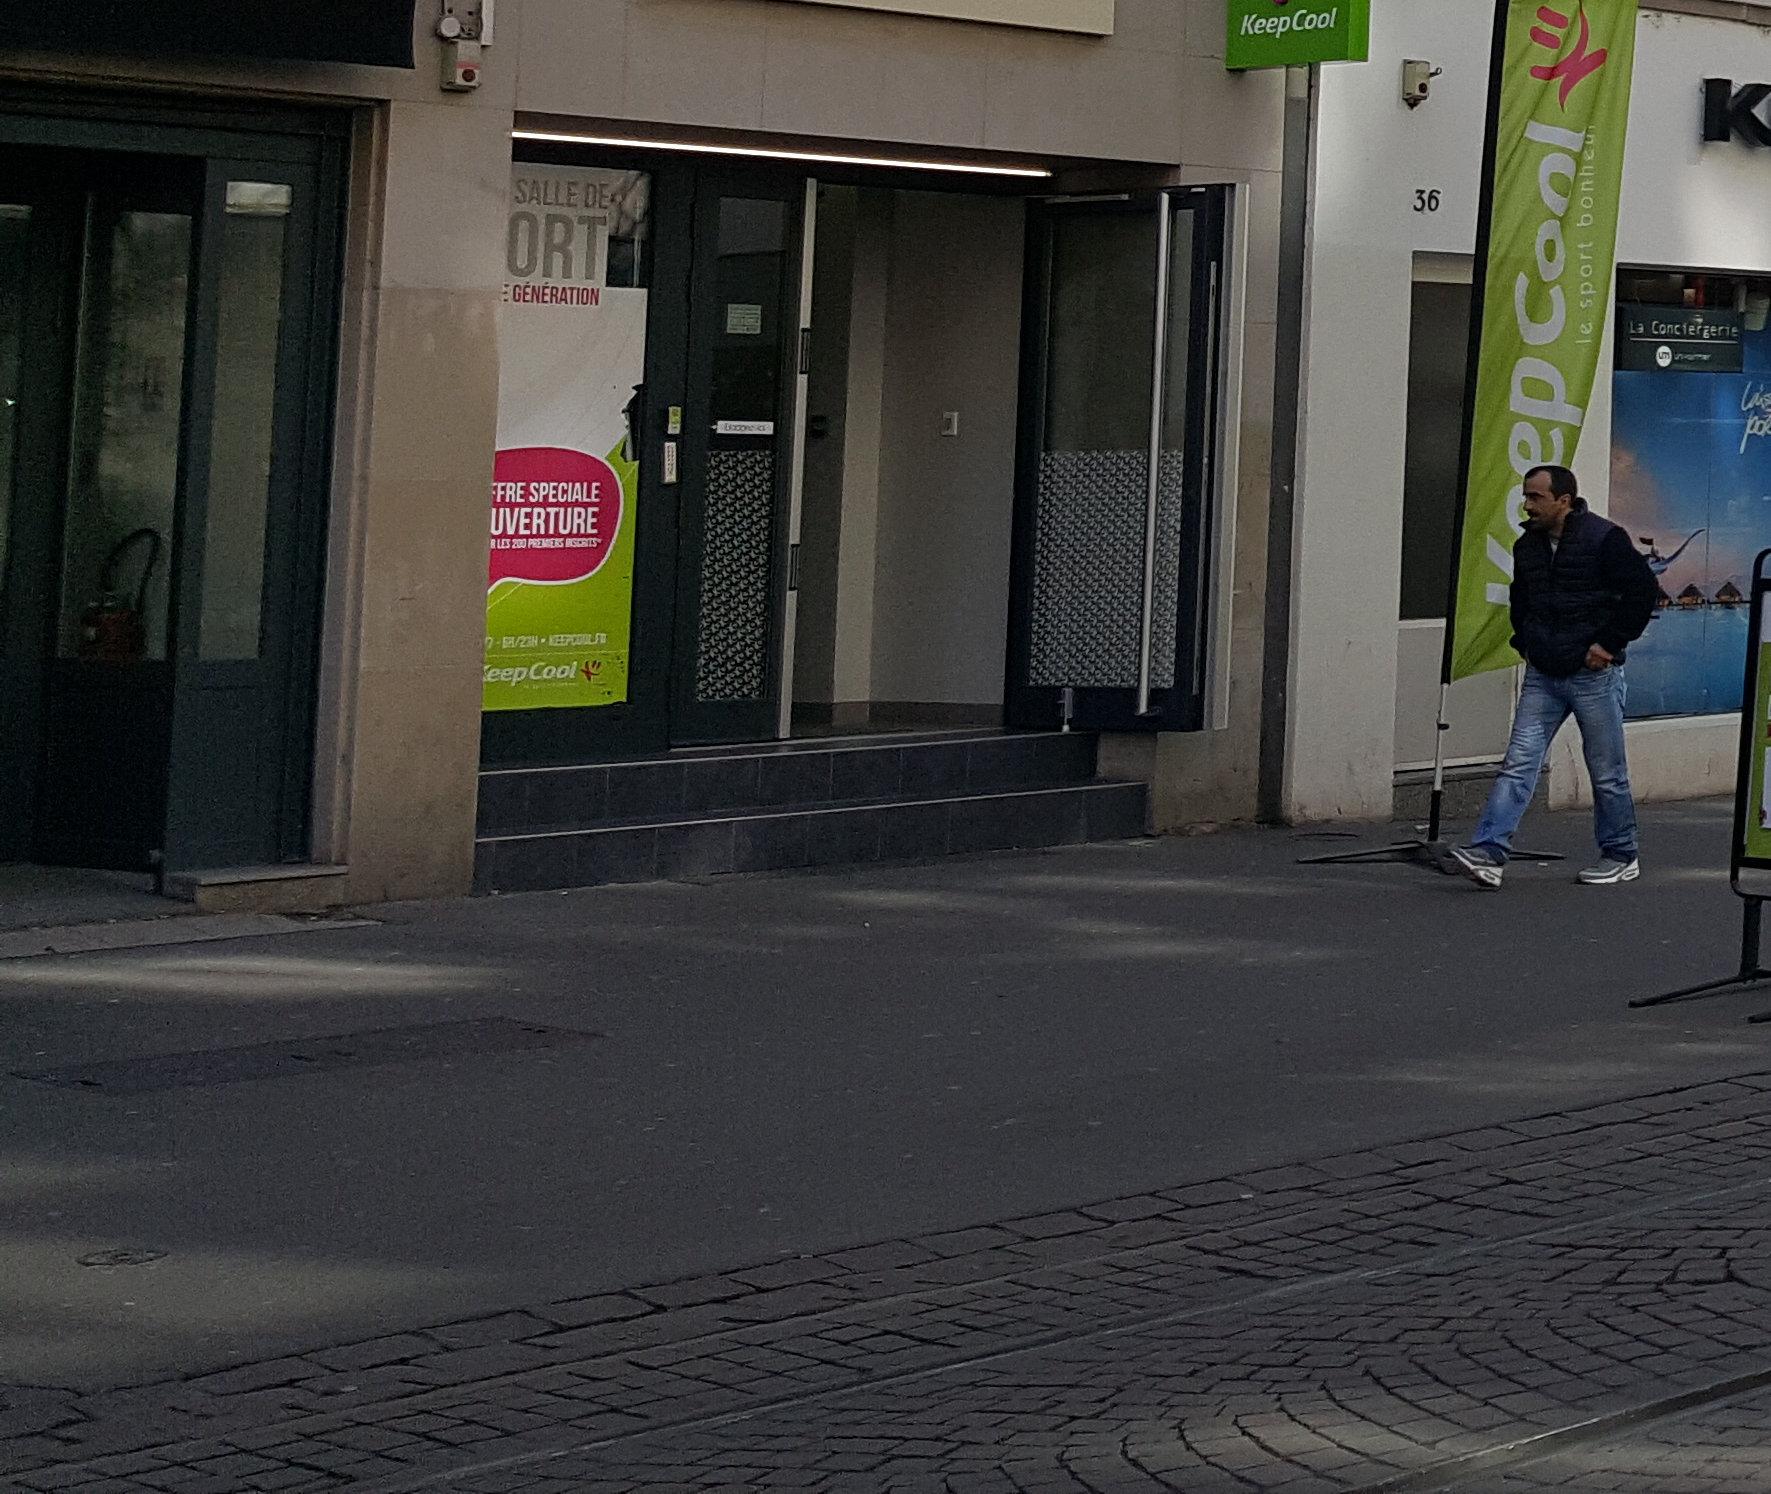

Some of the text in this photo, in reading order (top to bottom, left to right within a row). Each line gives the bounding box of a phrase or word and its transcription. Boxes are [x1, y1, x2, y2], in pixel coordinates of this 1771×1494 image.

[514, 178, 611, 210] SALLE DE
[1412, 189, 1441, 212] 36
[507, 211, 607, 280] ORT
[1577, 240, 1597, 309] sport
[512, 282, 600, 306] GÉNÉRATION
[1630, 320, 1739, 338] La Conciergerie
[529, 481, 601, 503] SPECIALE
[490, 507, 599, 535] UVERTURE
